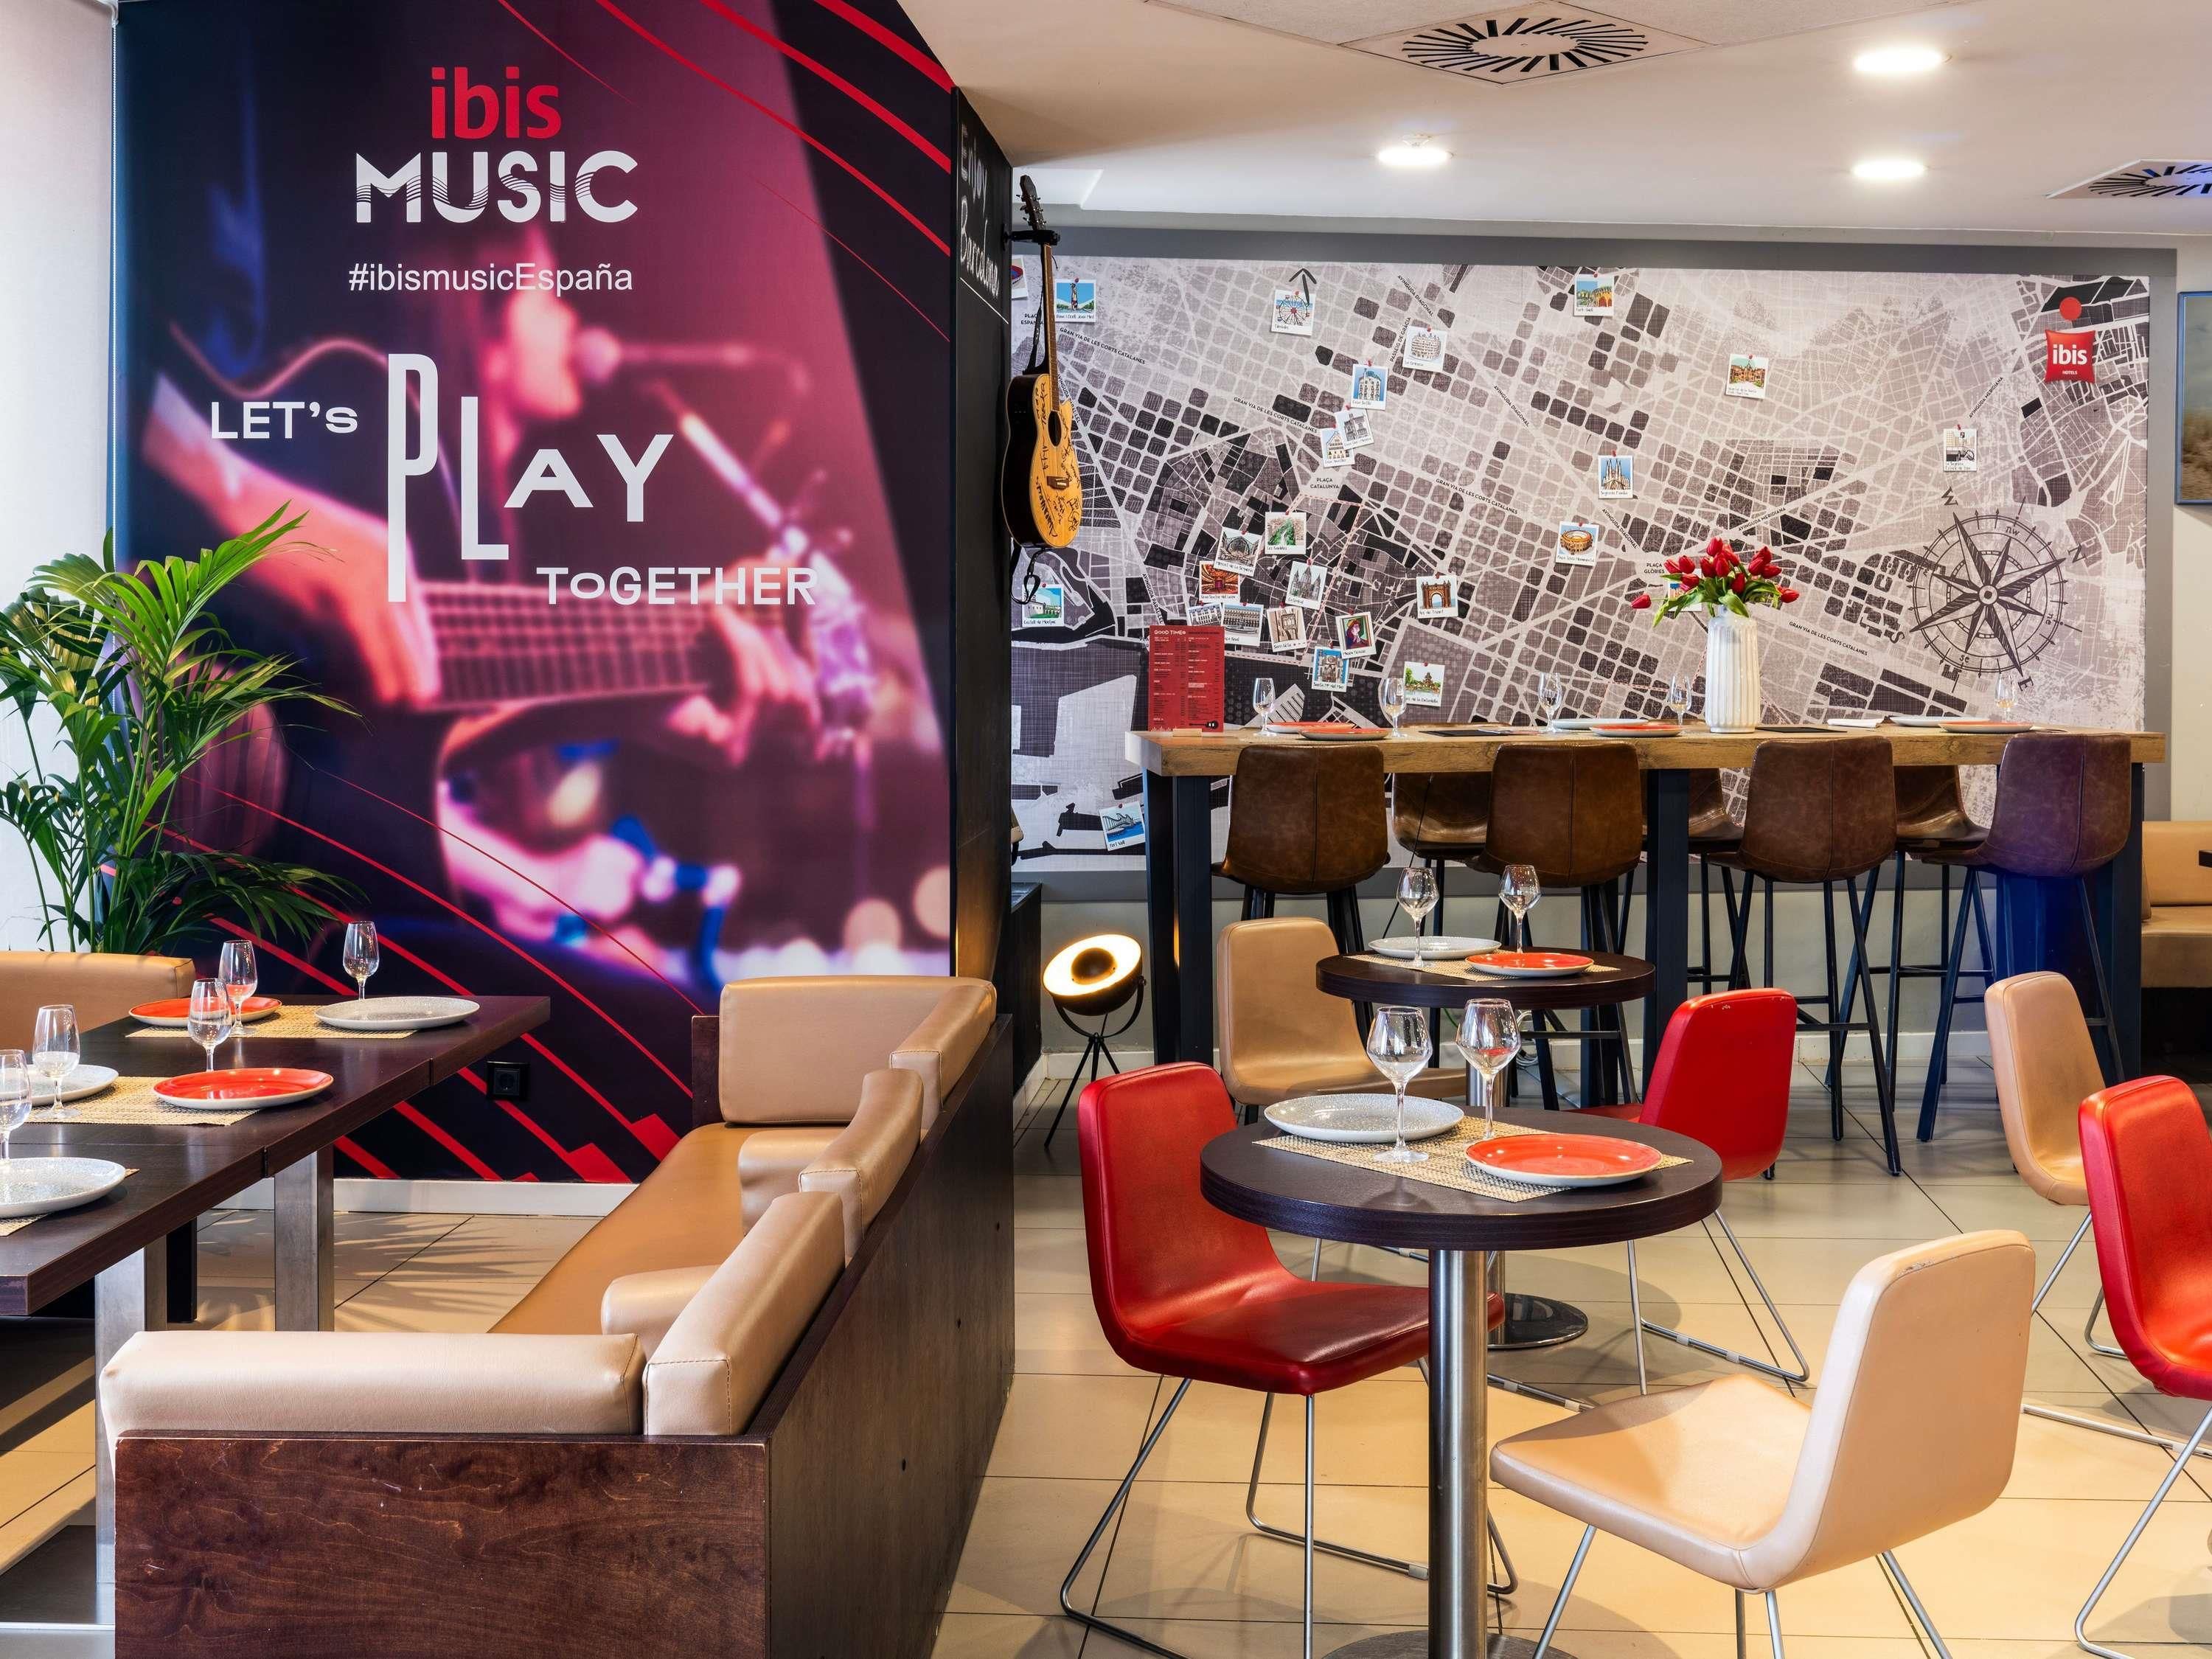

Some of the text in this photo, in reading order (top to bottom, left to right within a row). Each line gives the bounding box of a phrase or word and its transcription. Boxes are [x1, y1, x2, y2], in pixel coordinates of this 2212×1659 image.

[431, 66, 562, 139] ibis
[356, 150, 639, 223] MUSIC
[348, 262, 633, 296] #ibismusicEspaña
[1060, 327, 1074, 335] GRAN
[2052, 344, 2087, 365] ibis
[1234, 397, 1248, 406] GRAN
[387, 353, 674, 602] PLAY
[1436, 478, 1450, 487] GRAN
[536, 566, 818, 606] TOGETHER
[1789, 621, 1803, 630] GRAN
